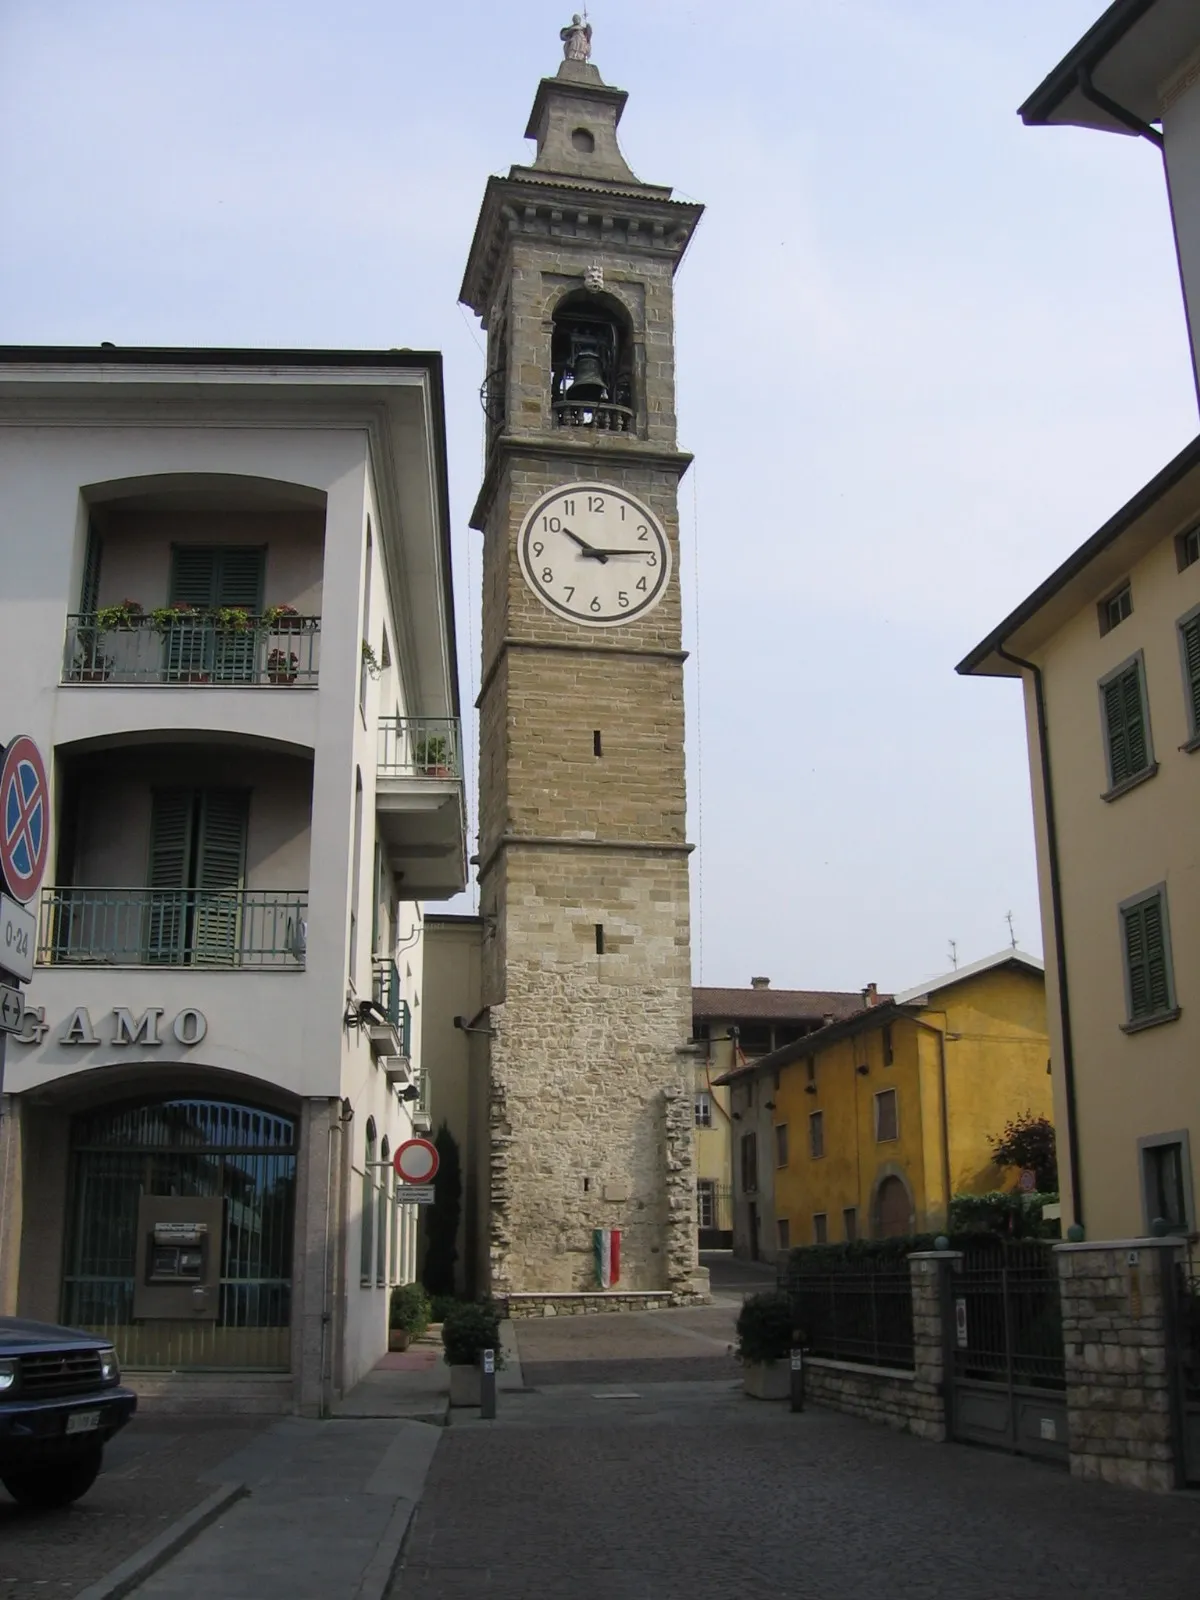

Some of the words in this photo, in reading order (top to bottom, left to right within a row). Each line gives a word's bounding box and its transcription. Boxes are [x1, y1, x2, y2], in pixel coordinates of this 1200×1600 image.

[563, 499, 575, 516] 11
[587, 496, 605, 513] 12
[620, 505, 626, 521] 1
[542, 516, 561, 533] 10
[636, 525, 648, 541] 2
[532, 542, 544, 557] 9
[646, 550, 657, 567] 3
[541, 567, 553, 583] 8
[635, 576, 648, 592] 4
[563, 586, 575, 603] 7
[618, 591, 629, 607] 5
[590, 596, 601, 612] 6
